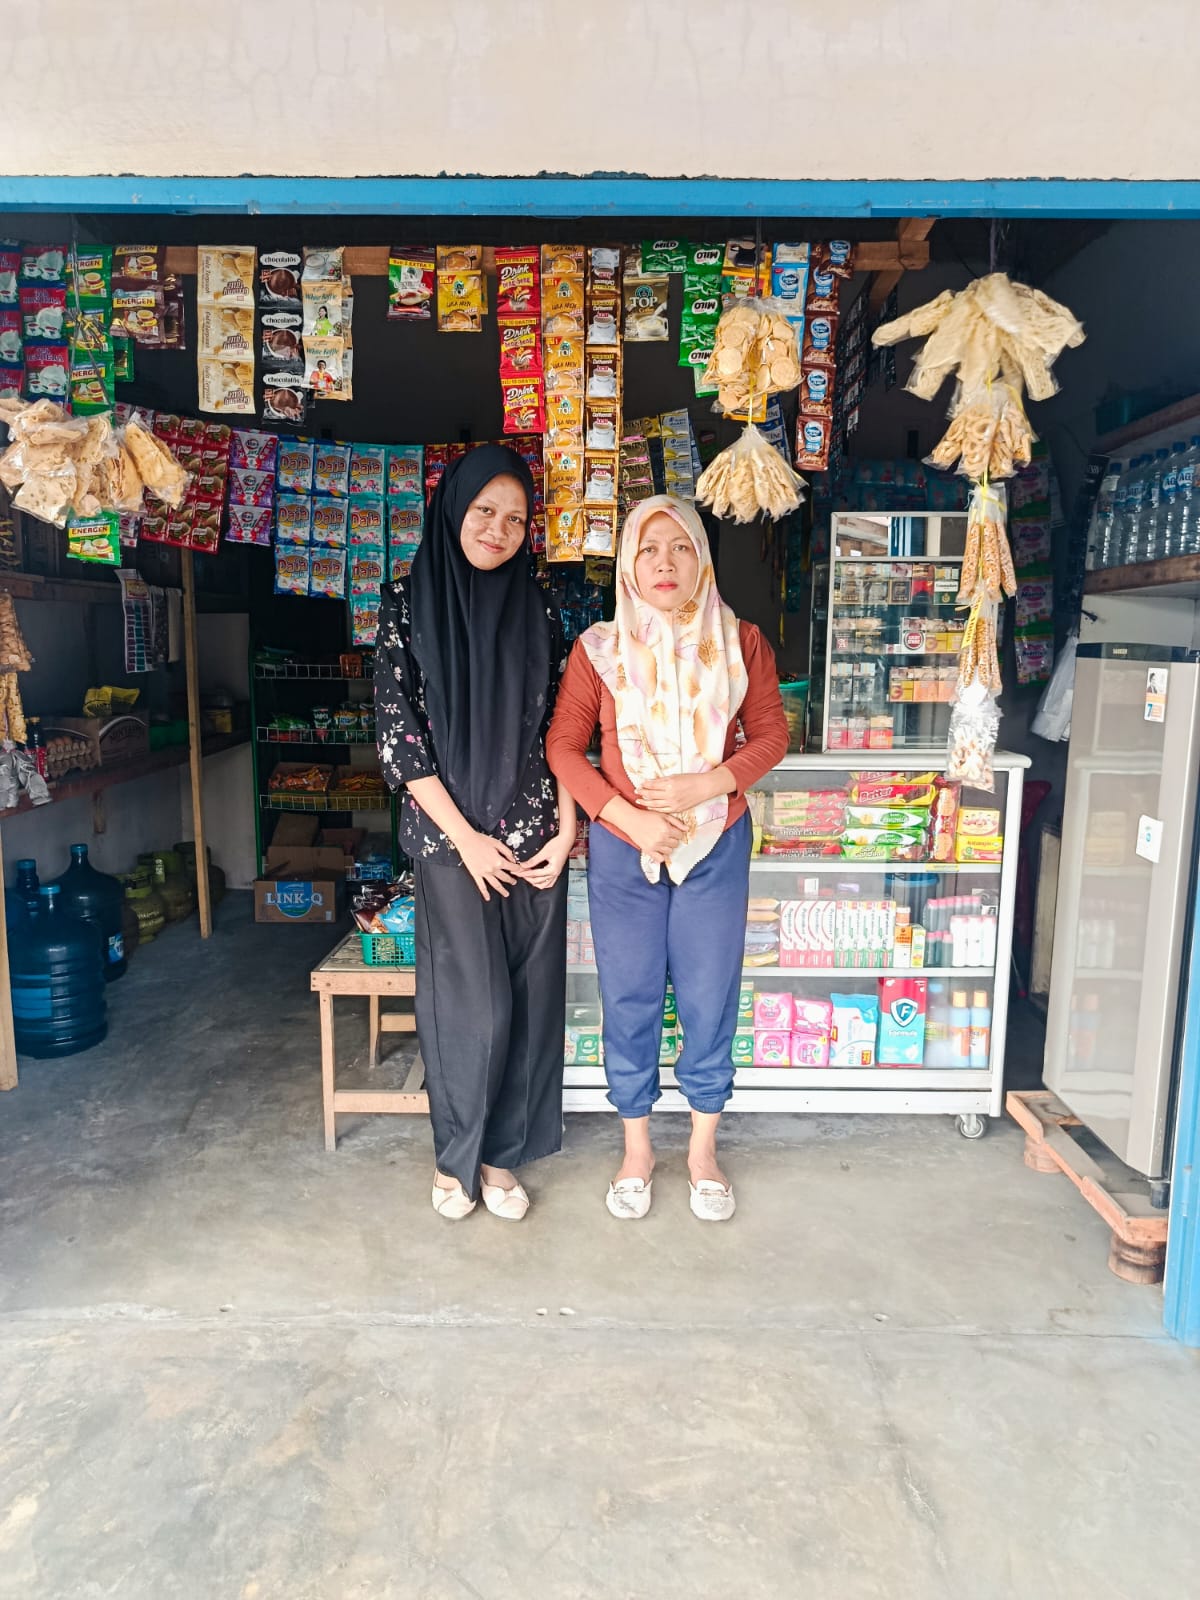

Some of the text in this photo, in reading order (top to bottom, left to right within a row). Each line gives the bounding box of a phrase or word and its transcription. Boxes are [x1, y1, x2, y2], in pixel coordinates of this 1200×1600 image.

[116, 298, 153, 306] ENERGEN
[629, 296, 658, 308] TOP
[693, 301, 715, 310] MILO
[280, 454, 310, 471] Daia
[316, 457, 347, 474] Daia
[351, 461, 382, 476] Daia
[389, 462, 419, 477] Daia
[278, 506, 309, 522] Daia
[314, 509, 344, 525] Daia
[351, 512, 381, 528] Daia
[391, 514, 420, 529] Daia
[71, 525, 108, 536] ENERGEN
[278, 558, 308, 574] Daia
[312, 560, 342, 577] Daia
[352, 563, 381, 580] Daia
[859, 787, 893, 803] Better
[266, 892, 323, 905] LINK-Q
[900, 1005, 910, 1018] F
